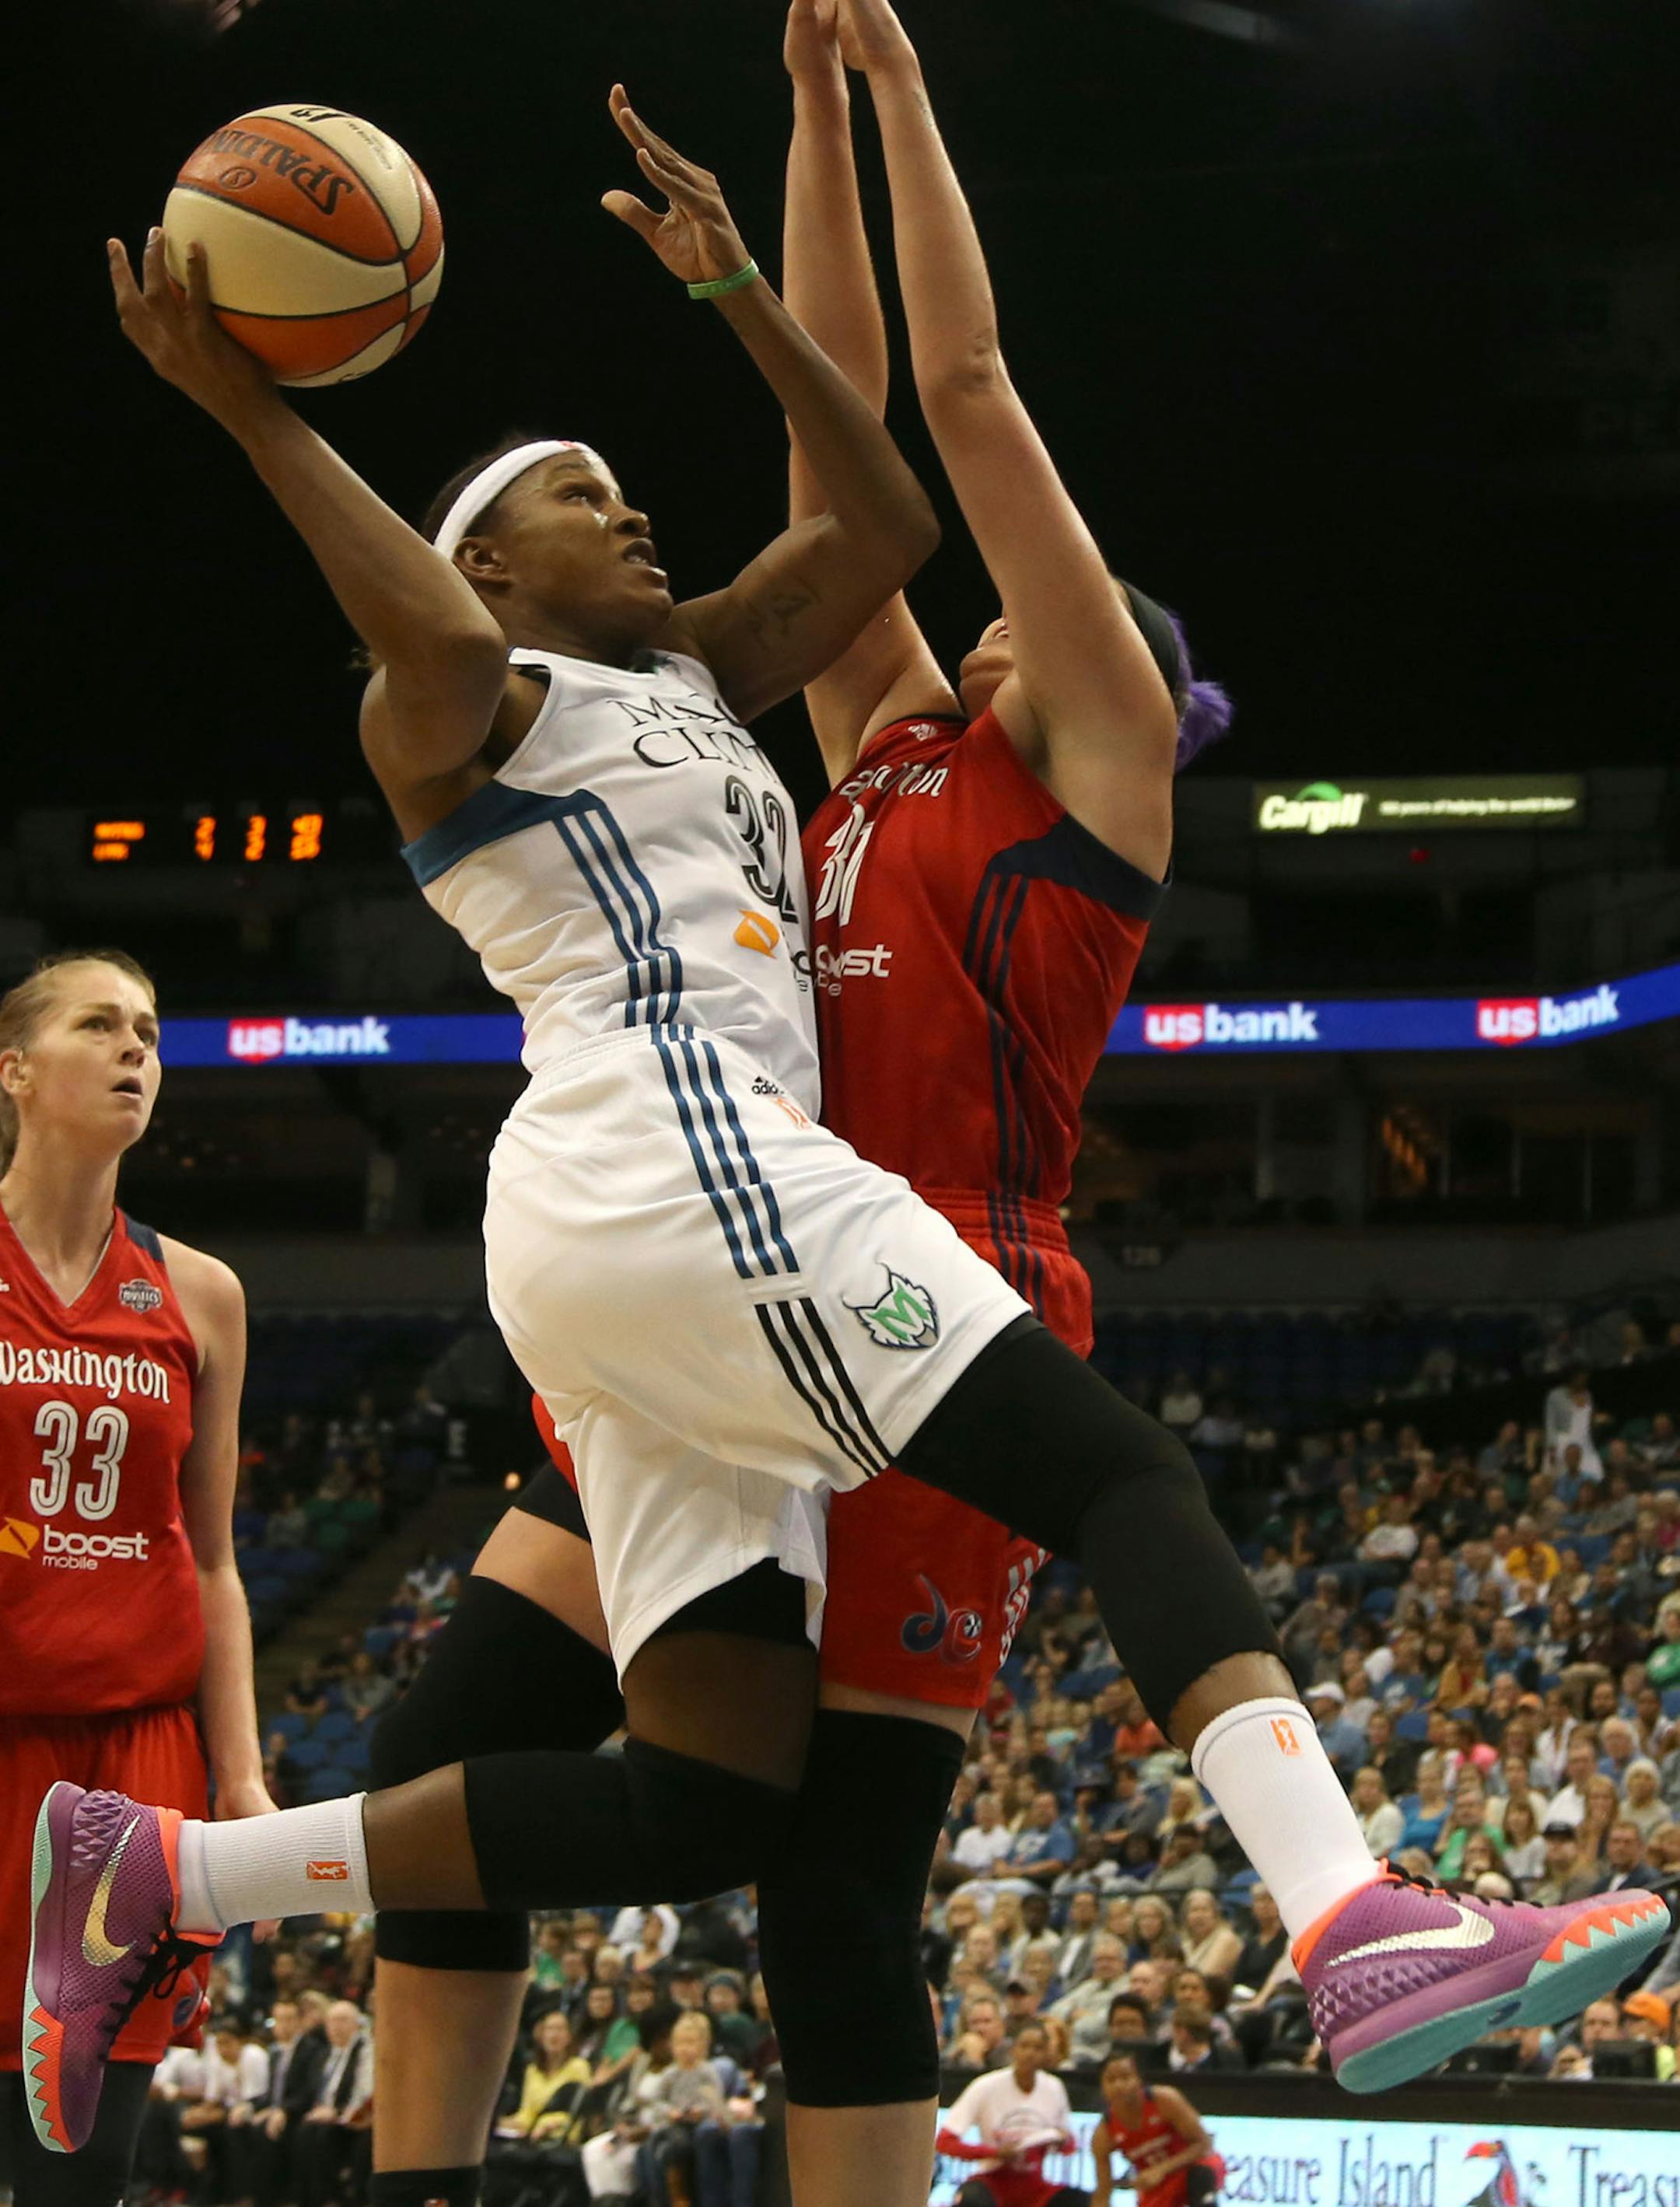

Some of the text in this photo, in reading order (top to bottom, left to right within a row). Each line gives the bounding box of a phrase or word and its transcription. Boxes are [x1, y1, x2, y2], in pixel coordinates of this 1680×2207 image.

[1260, 793, 1363, 834] Cargill
[725, 775, 799, 924] 32
[30, 1401, 129, 1521] 33
[42, 1555, 98, 1570] mobile
[44, 1524, 149, 1561] boost
[1338, 2134, 1438, 2207] Island
[1568, 2144, 1680, 2207] Treas
